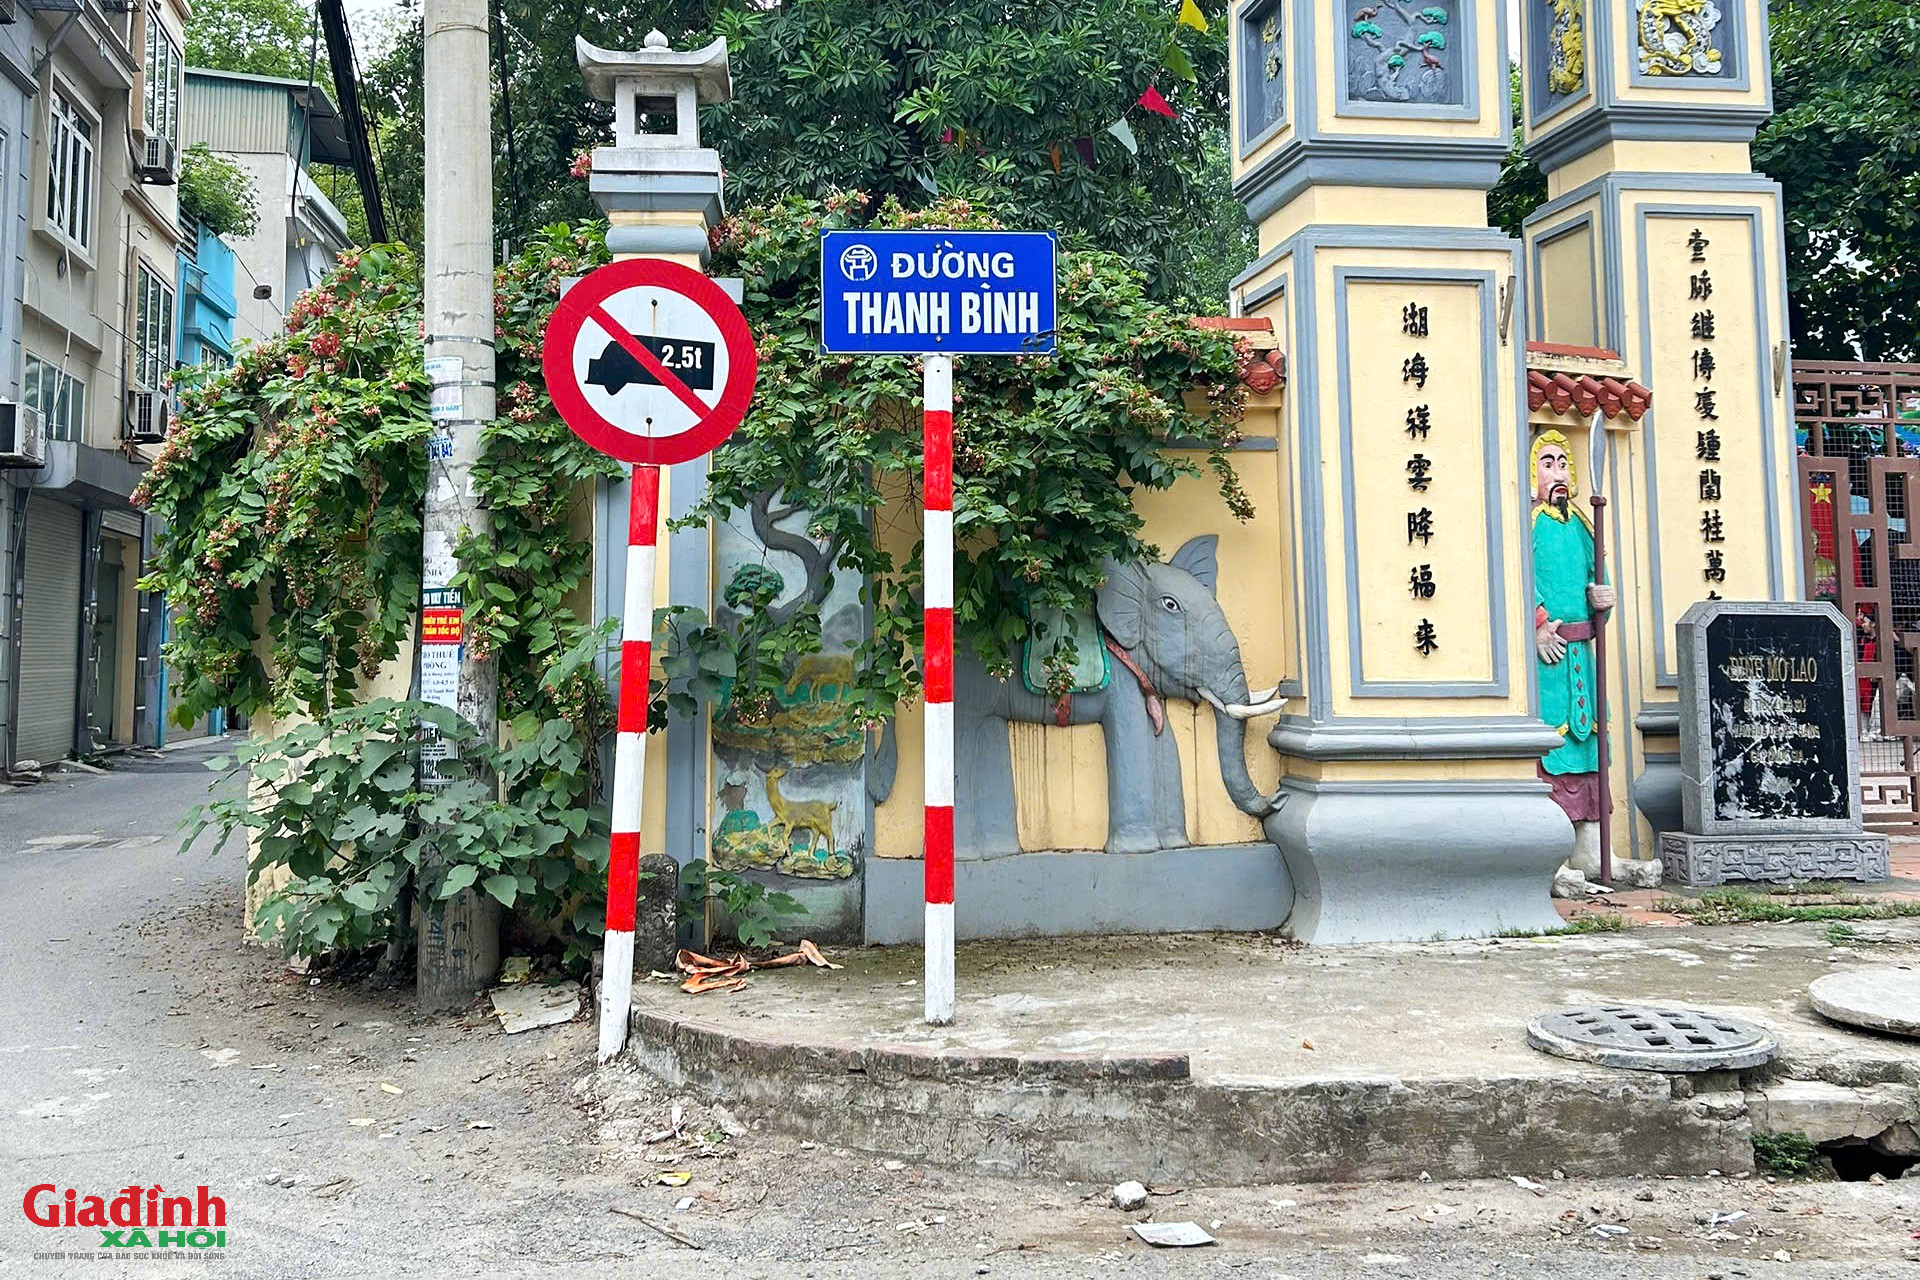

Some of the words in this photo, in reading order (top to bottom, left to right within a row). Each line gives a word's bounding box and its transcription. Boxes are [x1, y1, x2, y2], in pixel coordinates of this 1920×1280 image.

[891, 240, 1015, 278] ĐƯỜNG
[843, 291, 949, 334] THANH
[961, 282, 1039, 334] BÌNH
[661, 344, 702, 369] 2.5t
[1791, 657, 1818, 682] LAO
